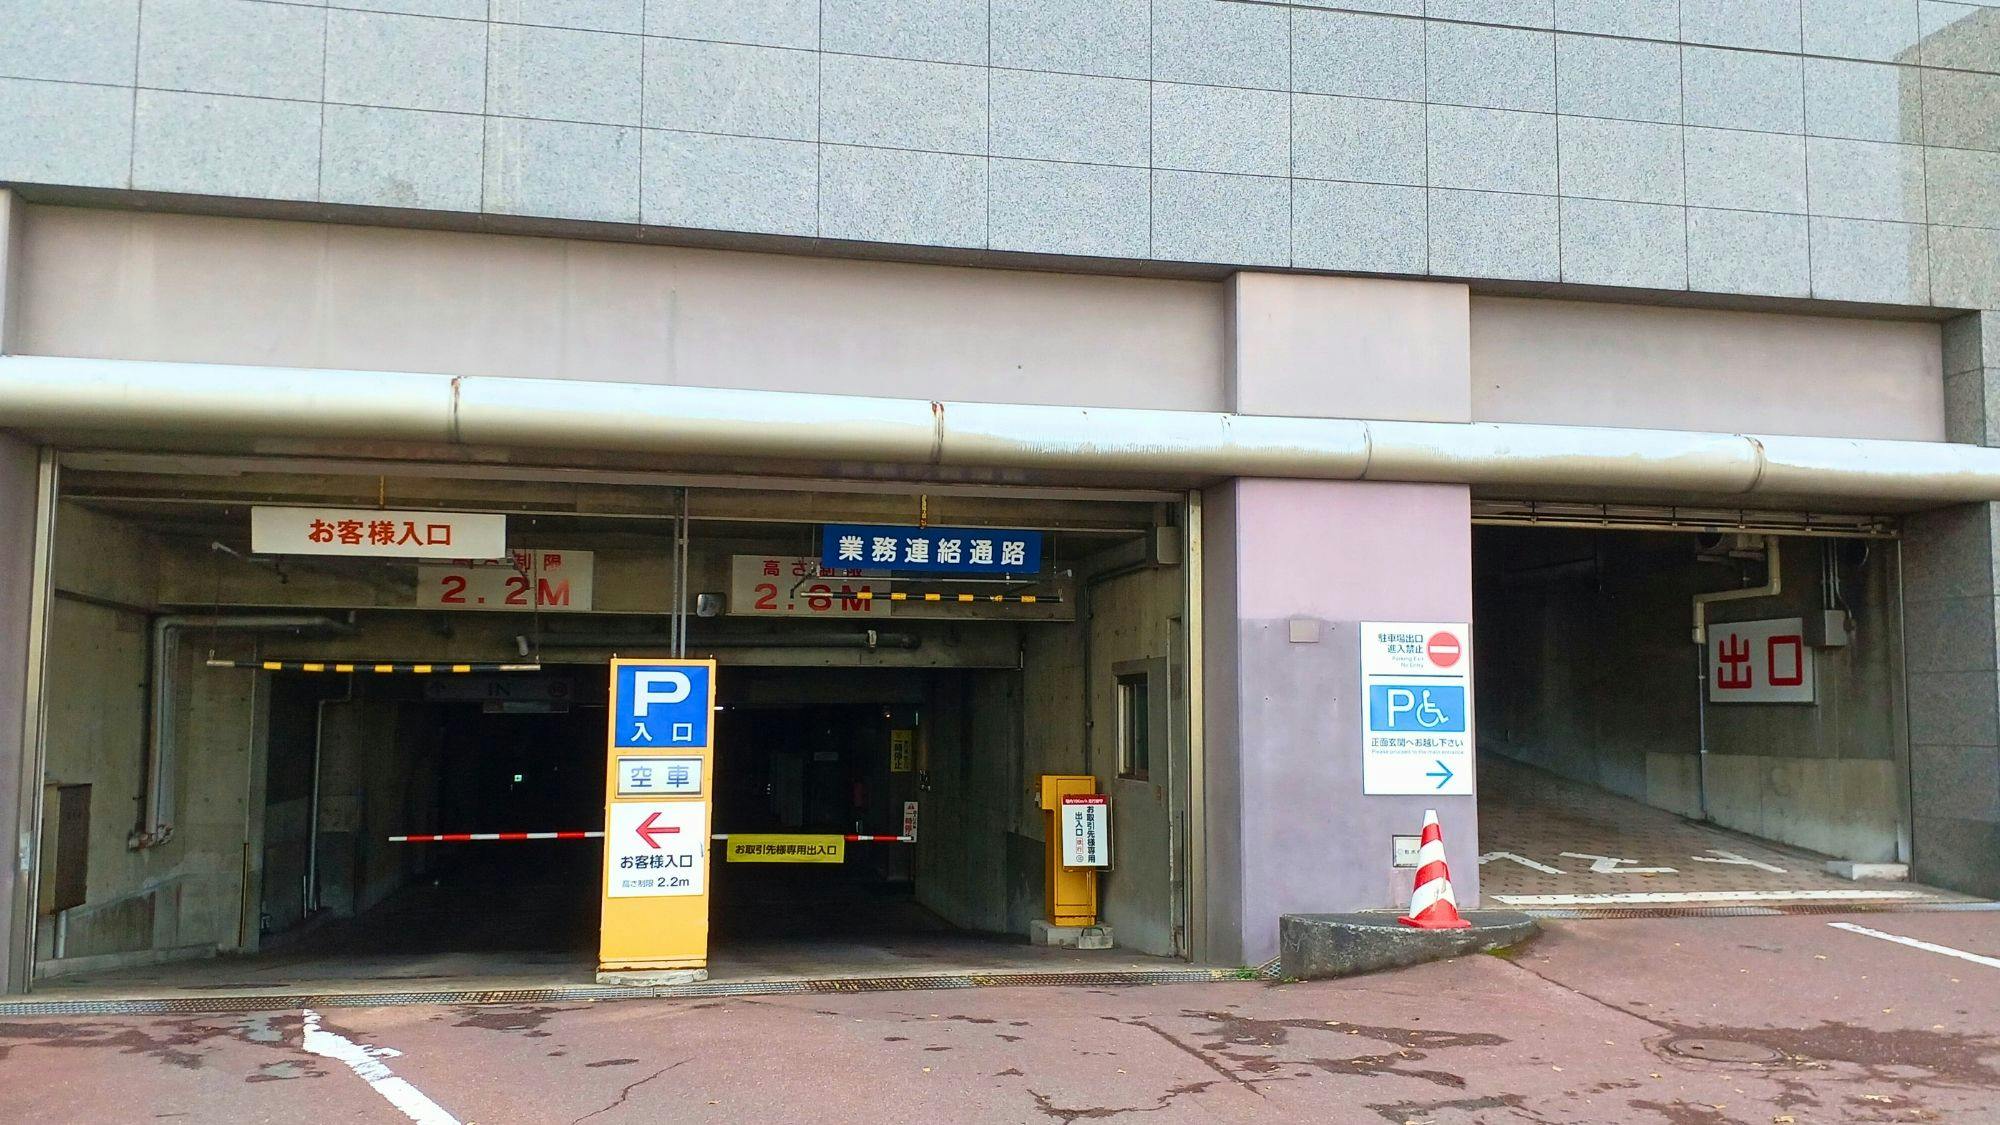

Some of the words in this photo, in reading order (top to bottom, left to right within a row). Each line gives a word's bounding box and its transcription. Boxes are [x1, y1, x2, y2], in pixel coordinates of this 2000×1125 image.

[309, 519, 452, 546] お客様入口
[838, 536, 1026, 566] 業務連絡通路
[441, 576, 570, 606] 2.2M
[1378, 633, 1424, 643] 駐車場出口
[1387, 644, 1424, 654] 進入禁止
[1717, 633, 1803, 690] 出口
[633, 670, 692, 717] P
[1387, 688, 1416, 728] P
[630, 722, 693, 742] 入口
[1371, 737, 1464, 748] 正面玄関へお越し下さい
[630, 765, 690, 789] 空車
[1074, 811, 1083, 836] 出入口
[1086, 805, 1096, 863] お取引先様専用
[620, 854, 693, 870] お客様入口
[735, 844, 837, 856] お取引先様専用出入口
[657, 876, 690, 888] 2.2m
